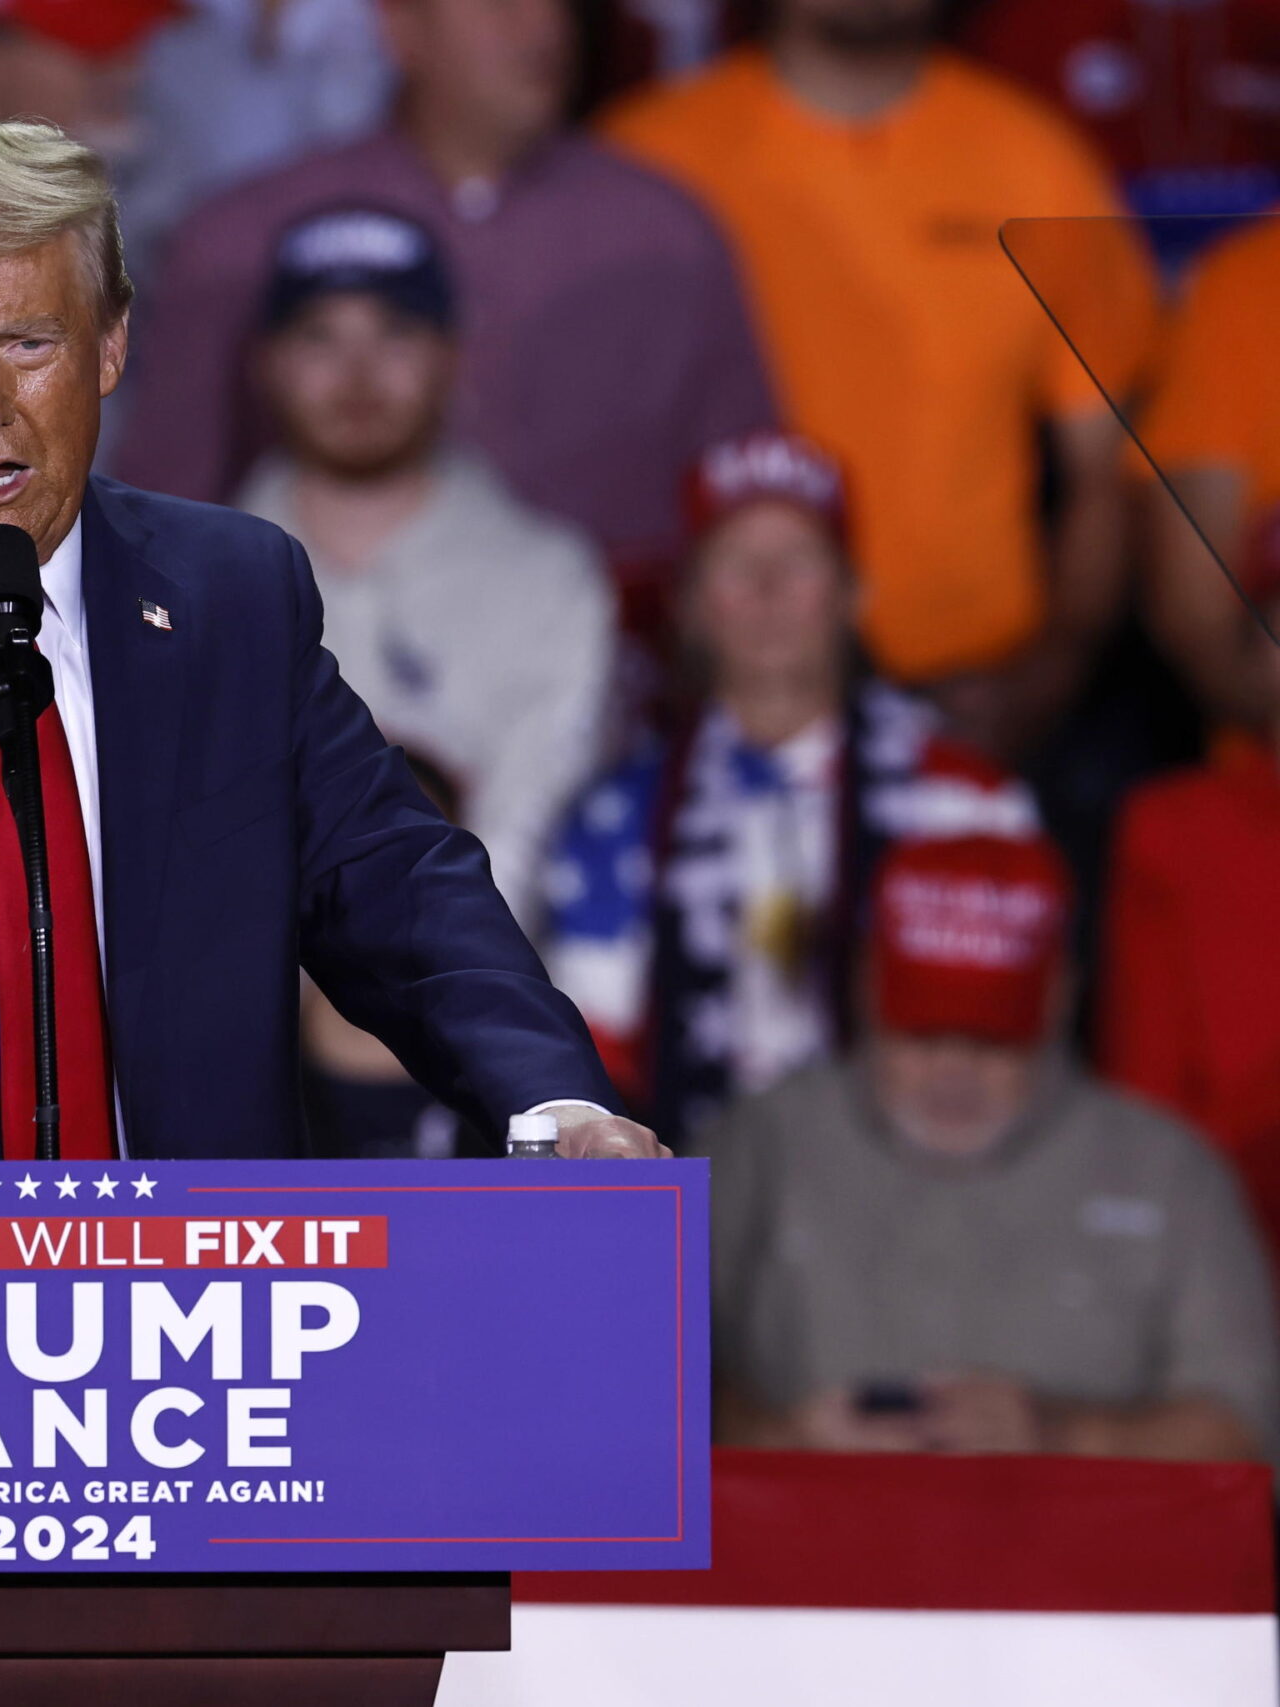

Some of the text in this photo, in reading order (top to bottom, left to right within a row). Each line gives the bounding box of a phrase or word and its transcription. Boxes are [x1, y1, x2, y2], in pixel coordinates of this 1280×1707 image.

[10, 1221, 164, 1266] WILL
[185, 1220, 285, 1265] FIX
[304, 1220, 360, 1265] IT
[83, 1480, 194, 1503] GREAT
[206, 1480, 324, 1503] AGAIN!
